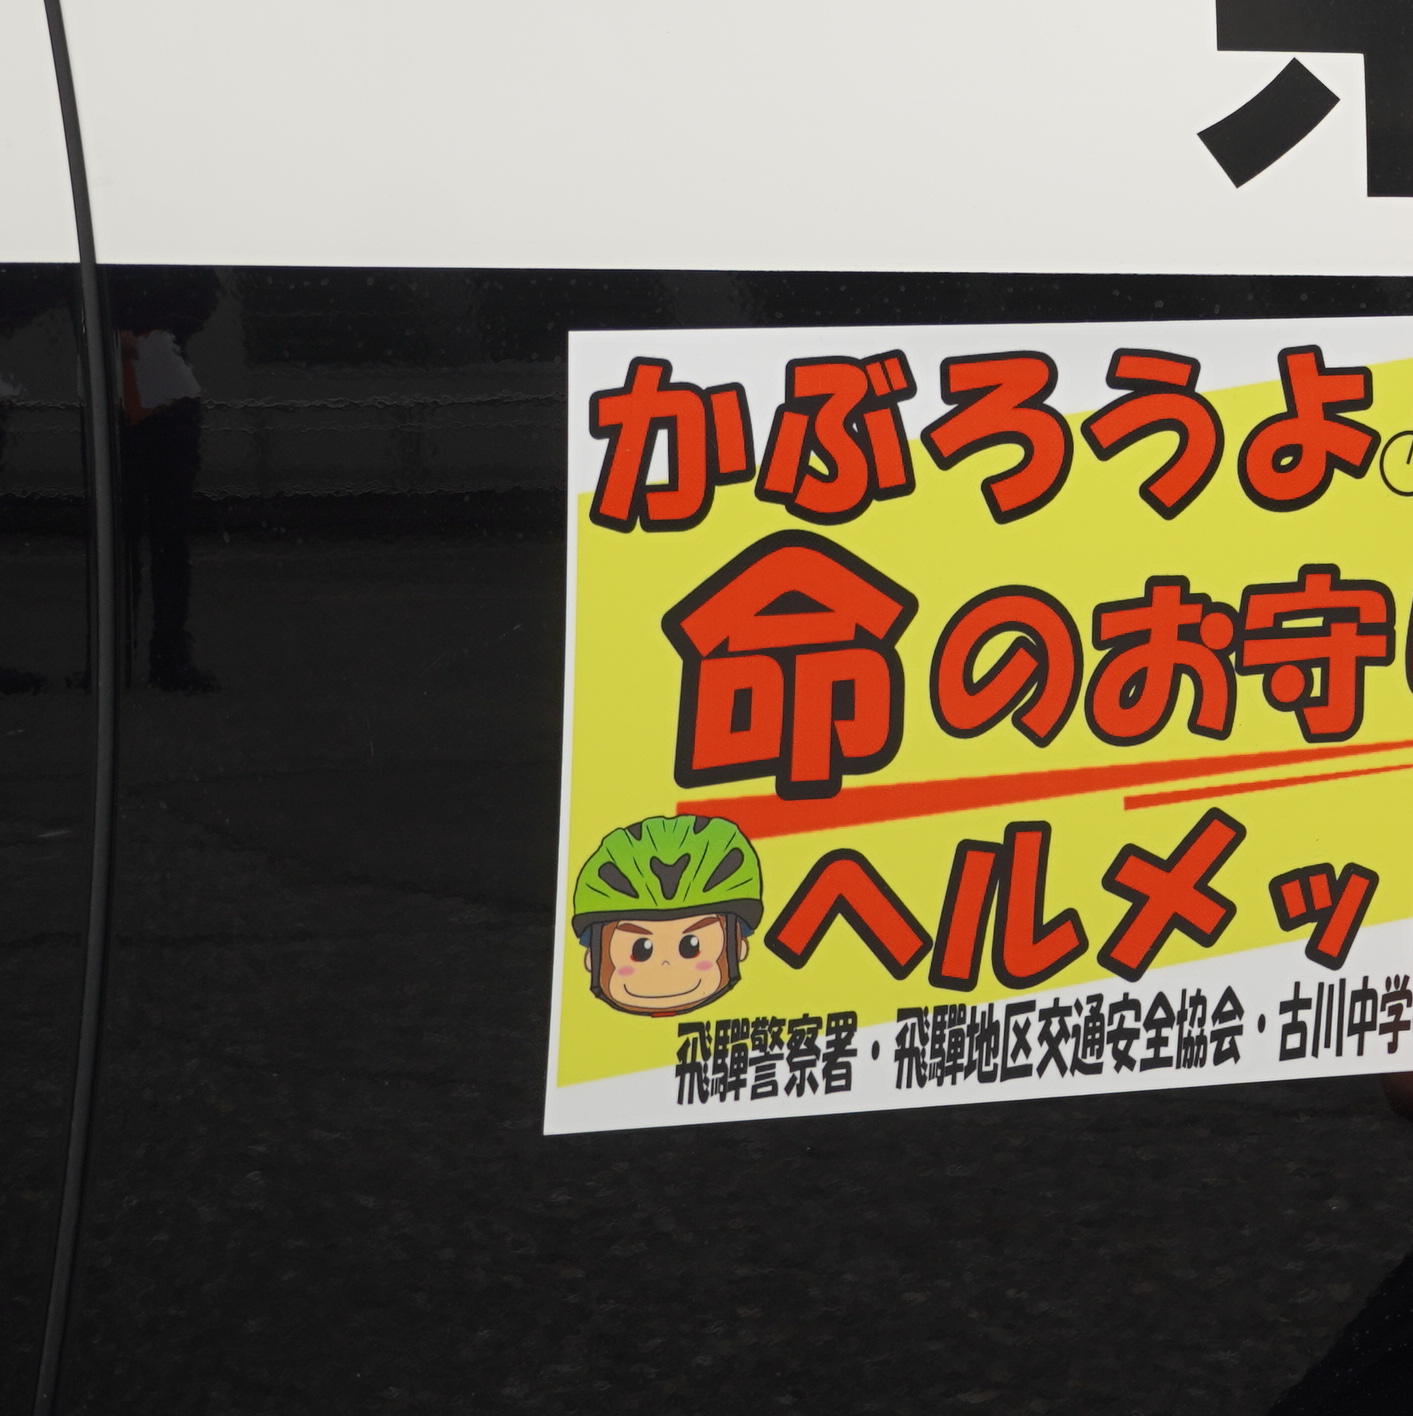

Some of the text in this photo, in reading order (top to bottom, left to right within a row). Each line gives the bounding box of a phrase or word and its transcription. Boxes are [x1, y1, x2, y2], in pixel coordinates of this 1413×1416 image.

[587, 344, 1379, 533] かぶろうよ
